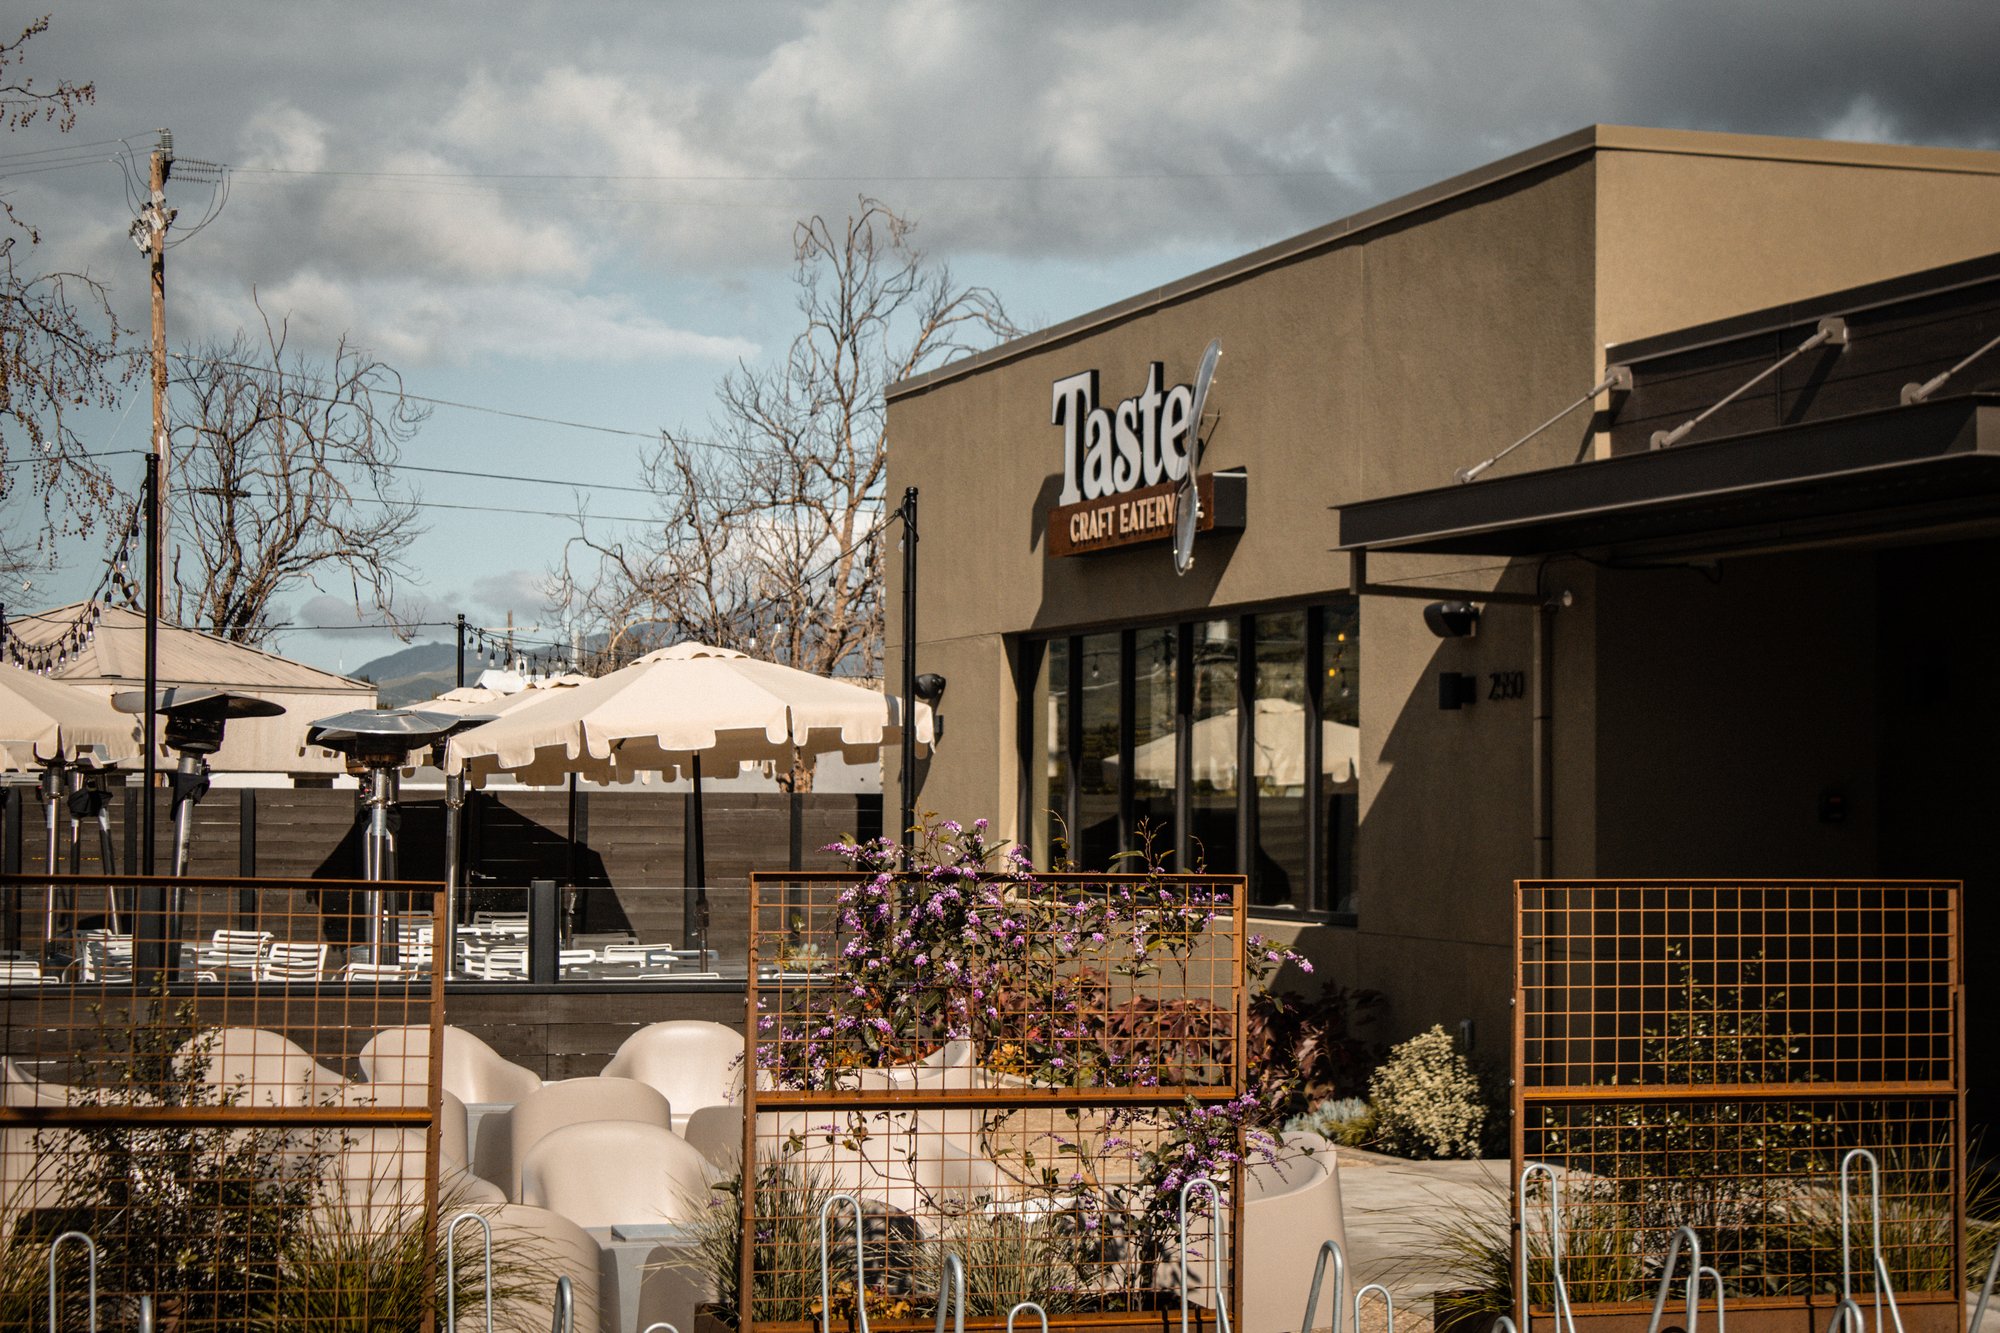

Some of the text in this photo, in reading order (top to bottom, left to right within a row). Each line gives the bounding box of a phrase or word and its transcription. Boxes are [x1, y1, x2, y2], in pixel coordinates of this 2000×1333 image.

[1051, 362, 1193, 507] Taste
[1070, 493, 1177, 543] CRAFT EATERY
